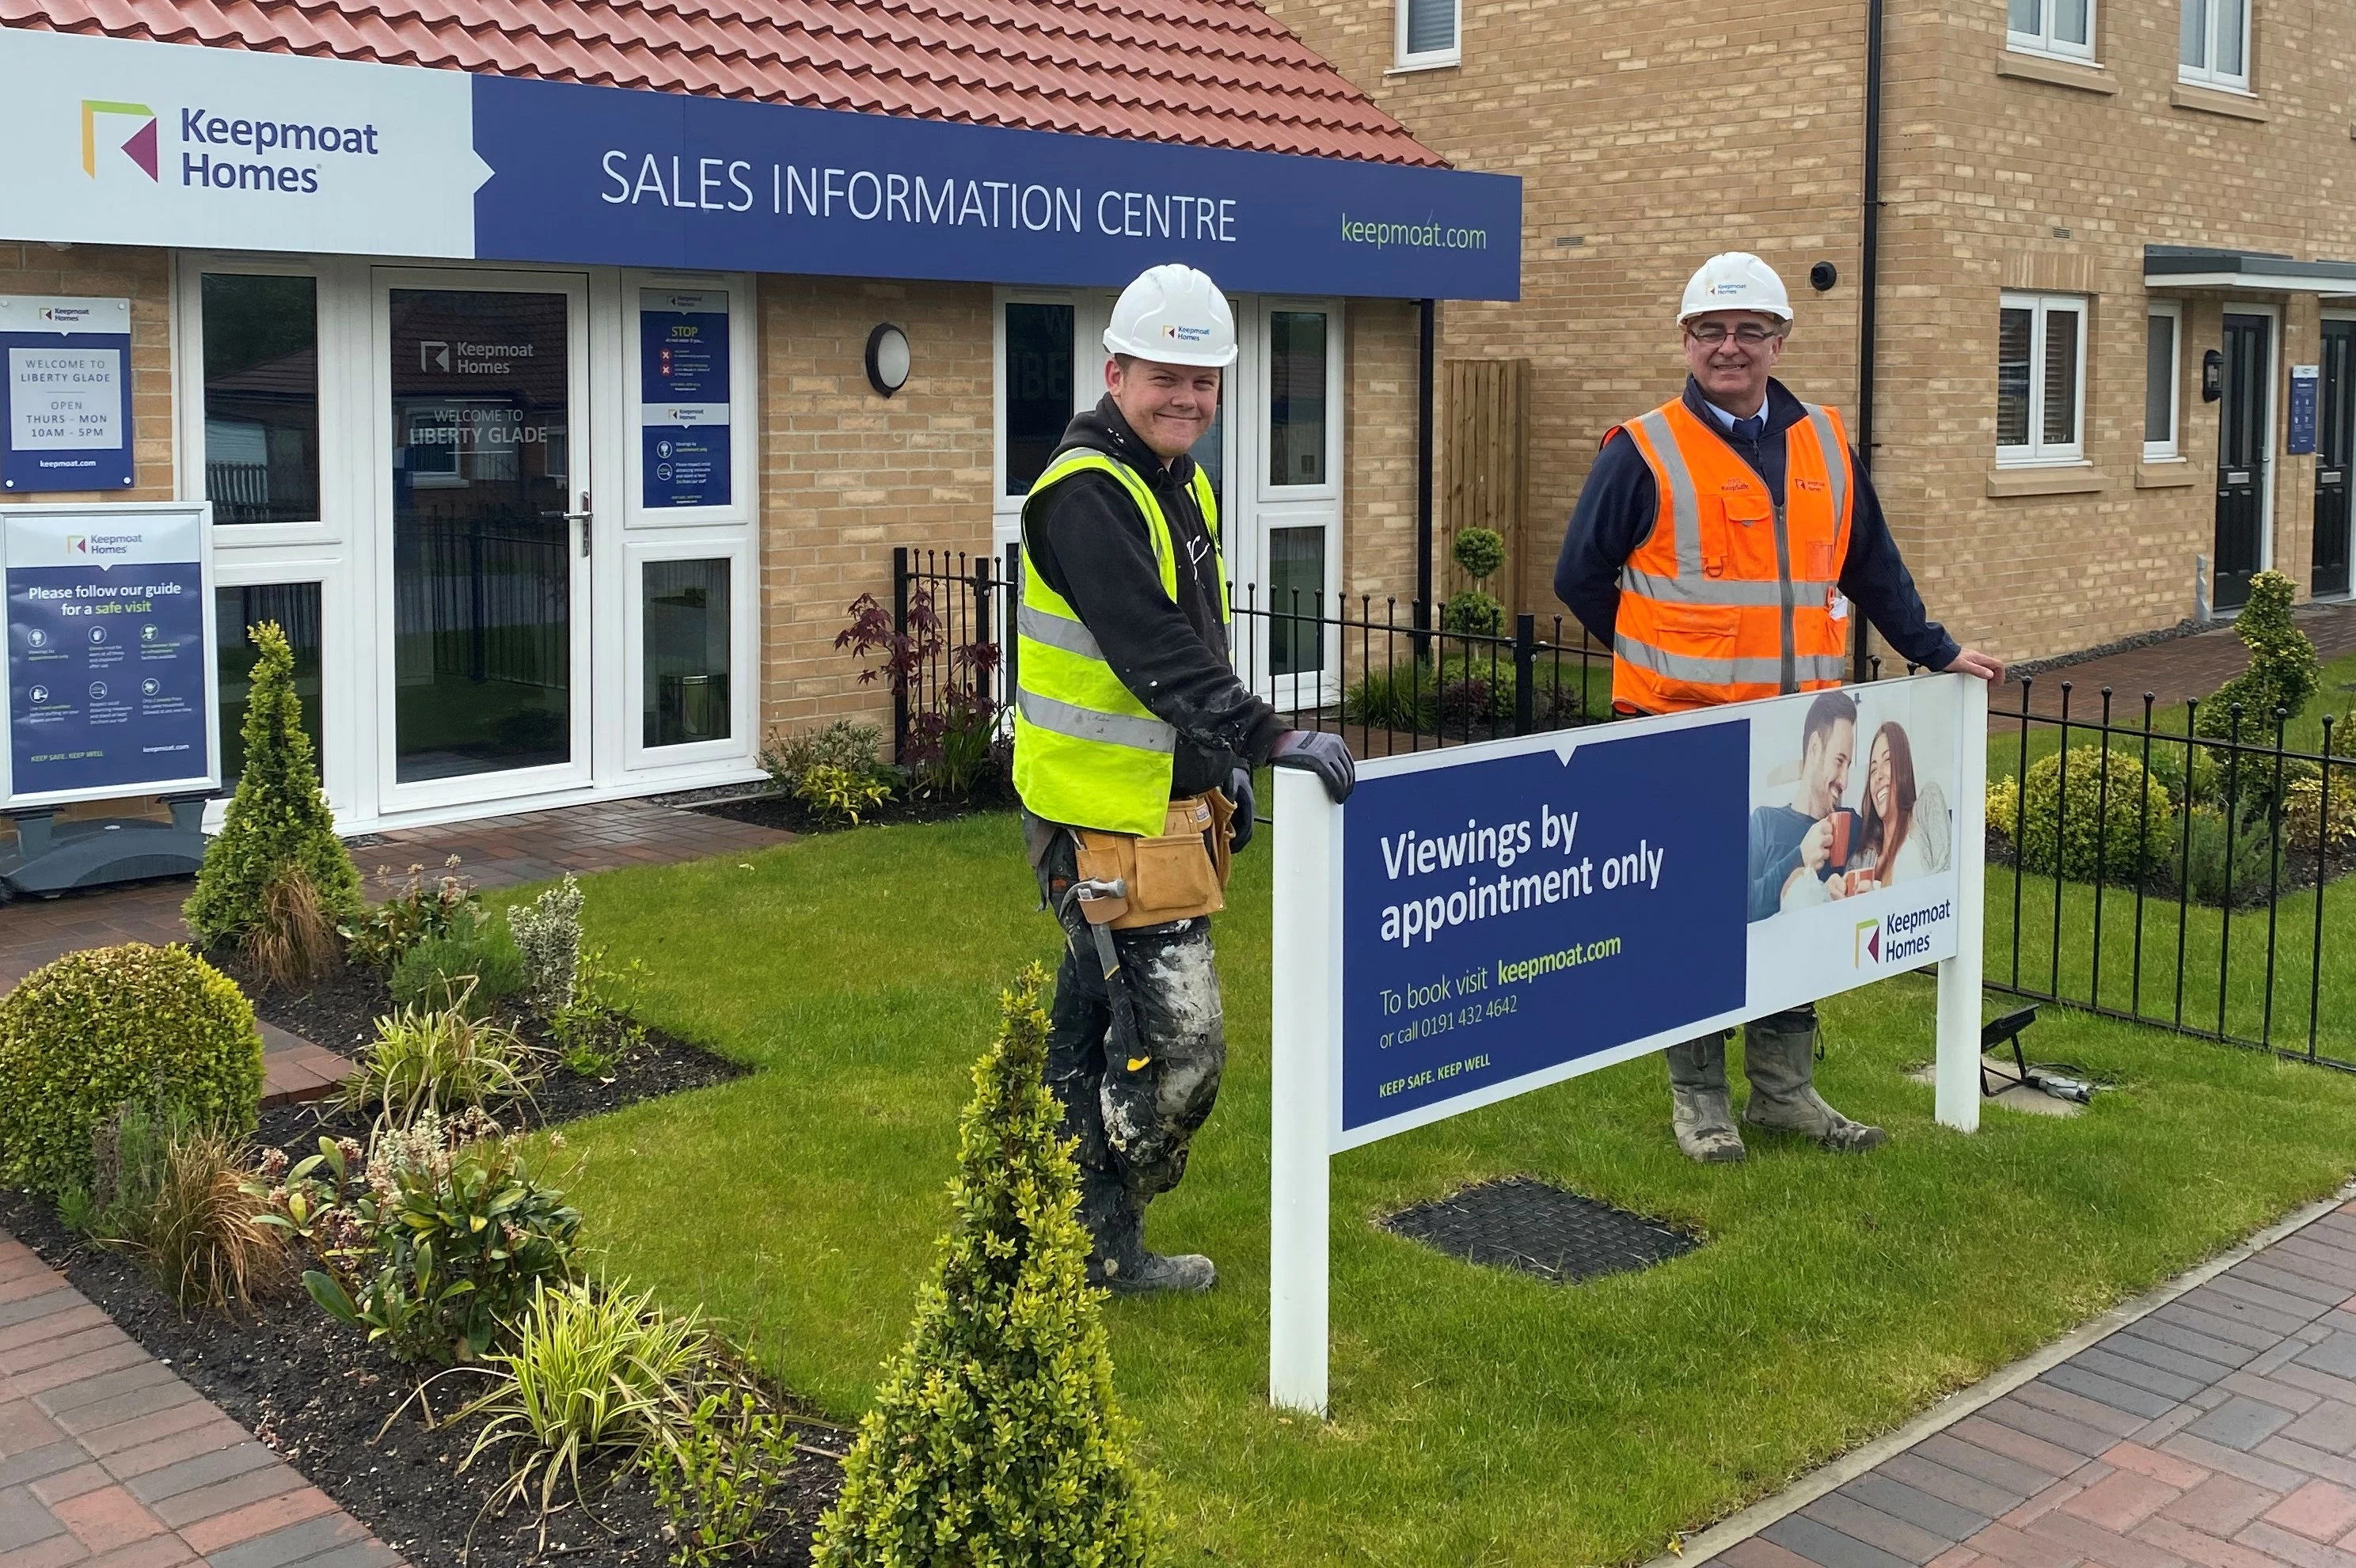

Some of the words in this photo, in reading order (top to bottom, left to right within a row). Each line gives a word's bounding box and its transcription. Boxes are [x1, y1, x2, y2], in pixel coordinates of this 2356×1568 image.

[180, 108, 378, 155] Keepmoat
[182, 152, 318, 193] Homes
[601, 150, 754, 212] SALES
[773, 163, 1082, 233] INFORMATION
[1096, 190, 1237, 242] CENTRE
[1342, 212, 1488, 250] keepmoat.com
[671, 326, 698, 337] STOP
[1178, 325, 1210, 335] Keepmoat
[1178, 332, 1200, 341] Homes
[457, 341, 534, 359] Keepmoat
[25, 359, 85, 369] WELCOME
[91, 360, 105, 369] TO
[457, 359, 511, 374] Homes
[21, 373, 68, 382] LIBERTY
[73, 373, 110, 382] GLADE
[51, 401, 82, 410] OPEN
[26, 415, 65, 423] THURS
[80, 415, 107, 423] MON
[434, 409, 501, 422] WELCOME
[507, 409, 523, 421] TO
[31, 428, 64, 437] 10AM
[78, 428, 103, 437] 5PM
[409, 427, 482, 445] LIBERTY
[488, 427, 548, 444] GLADE
[40, 460, 96, 469] keepmoat.com
[90, 533, 142, 544] Keepmoat
[91, 545, 127, 554] Homes
[28, 587, 73, 600] Please
[74, 584, 116, 598] follow
[120, 585, 142, 596] our
[145, 582, 181, 598] guide
[61, 603, 82, 617] for
[84, 606, 92, 615] a
[95, 602, 121, 614] safe
[124, 600, 152, 613] visit
[1380, 818, 1531, 880] Viewings
[1541, 804, 1579, 855] by
[1380, 857, 1593, 948] appointment
[1602, 839, 1664, 890] only
[1887, 898, 1951, 936] Keepmoat
[1886, 934, 1930, 962] Homes
[1379, 989, 1401, 1016] To
[1408, 974, 1451, 1010] book
[1456, 966, 1488, 997] visit
[1498, 936, 1621, 986] keepmoat.com
[1380, 1032, 1395, 1049] or
[1397, 1019, 1418, 1044] call
[1421, 1012, 1454, 1038] 0191
[1458, 1004, 1483, 1026] 432
[1485, 995, 1518, 1019] 4642
[1379, 1078, 1405, 1099] KEEP
[1407, 1070, 1435, 1090] SAFE.
[1438, 1061, 1462, 1080] KEEP
[1465, 1053, 1491, 1073] WELL
